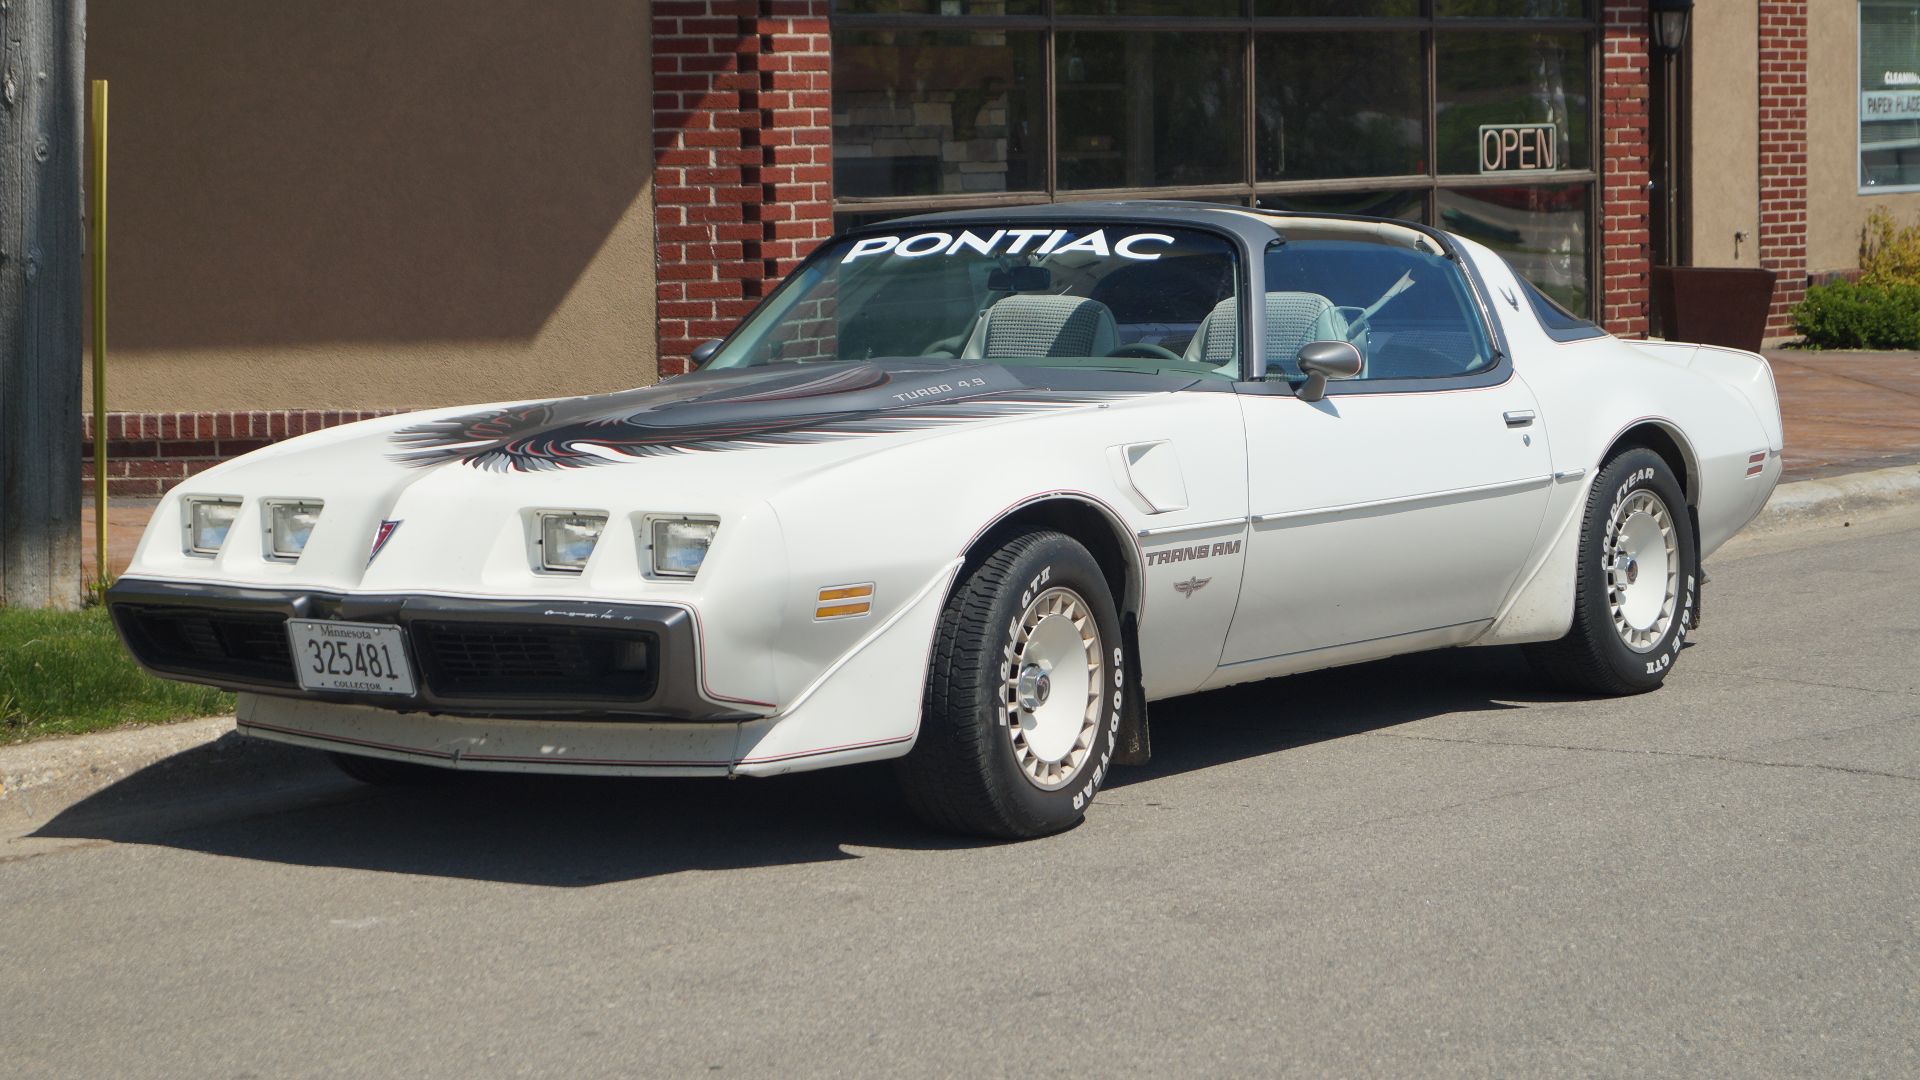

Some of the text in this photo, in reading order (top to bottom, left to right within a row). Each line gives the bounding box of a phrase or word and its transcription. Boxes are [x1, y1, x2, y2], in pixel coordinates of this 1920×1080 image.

[1868, 97, 1892, 114] PAPER
[1483, 128, 1553, 170] OPEN
[841, 229, 1176, 264] PONTIAC
[892, 377, 986, 401] TURBO 4.9
[1601, 467, 1655, 571] GOODYEAR
[1146, 540, 1241, 567] TRANS AM
[320, 624, 371, 640] Minnesota
[1672, 574, 1695, 653] EAGLE
[308, 639, 399, 680] 325481
[999, 616, 1018, 726] EAGLE
[333, 680, 381, 690] COLLECTOR
[1073, 647, 1123, 810] GOODYEAR
